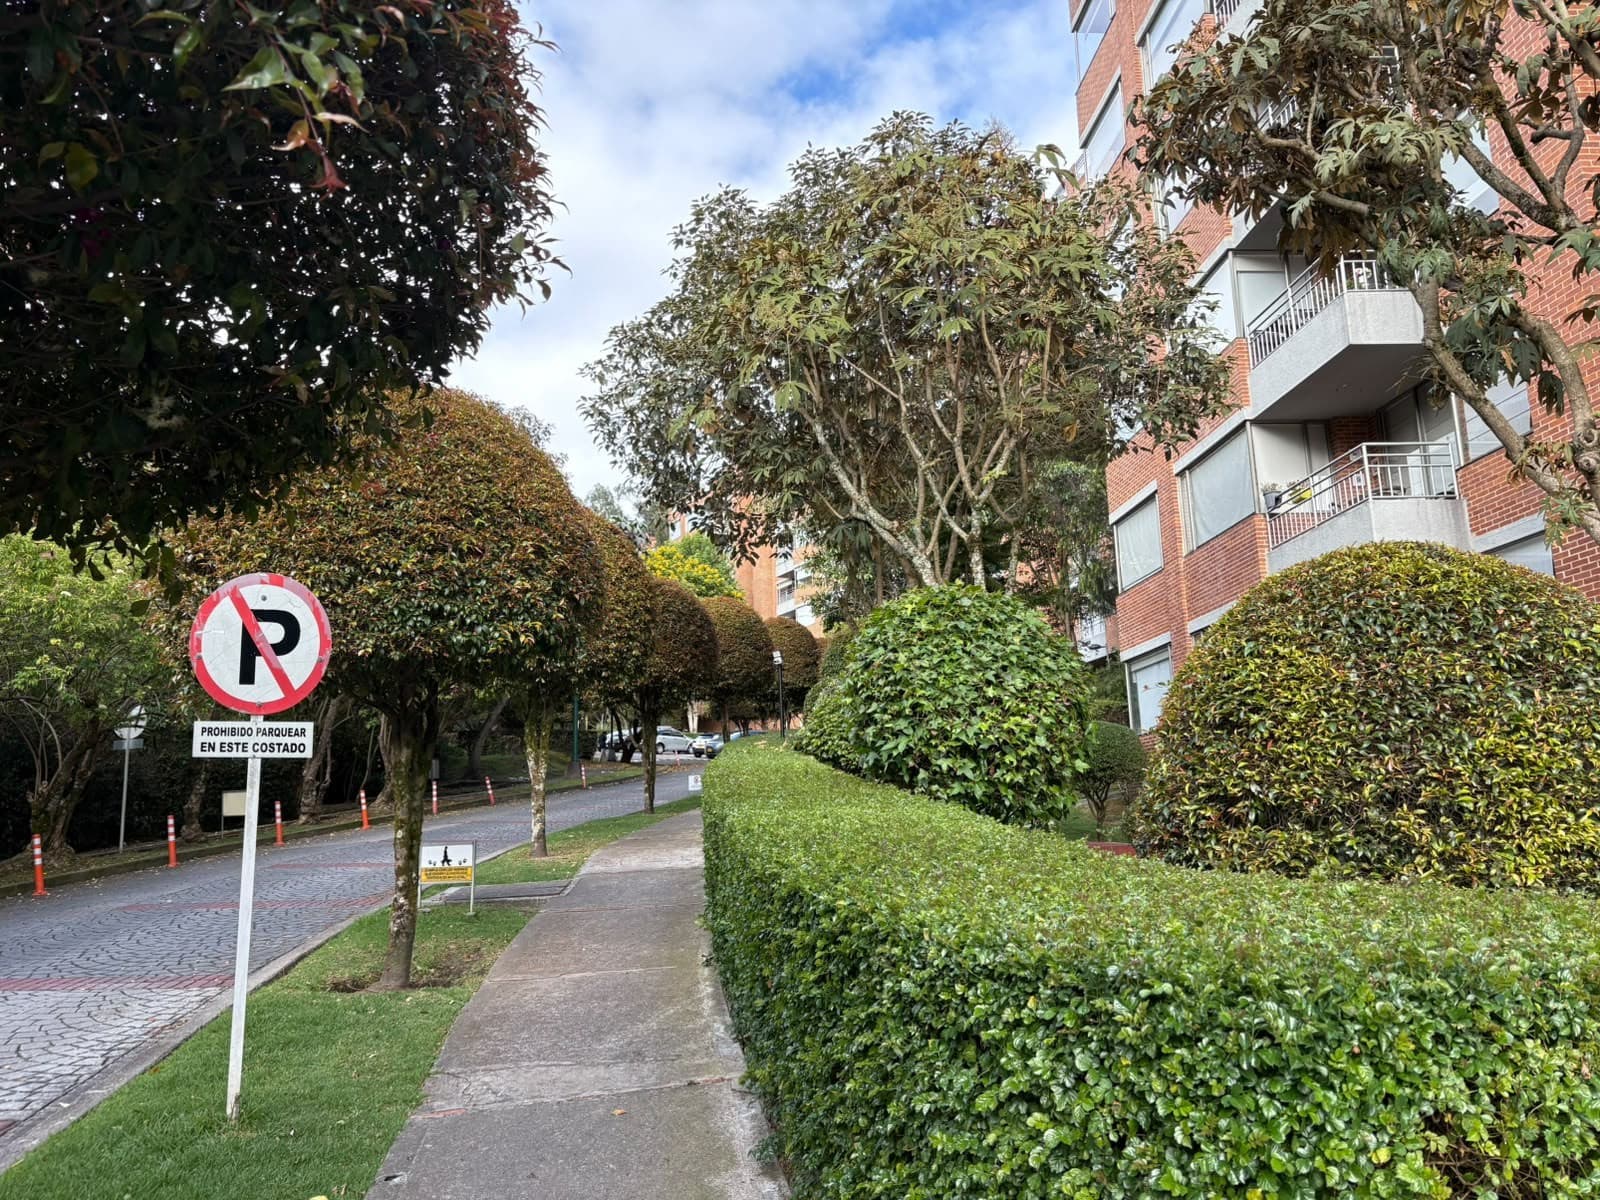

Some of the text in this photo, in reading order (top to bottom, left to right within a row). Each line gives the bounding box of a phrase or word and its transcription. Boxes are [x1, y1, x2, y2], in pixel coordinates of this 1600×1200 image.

[239, 609, 300, 685] P
[201, 726, 306, 738] PROHIBIDO PARQUEAR
[200, 742, 306, 753] EN ESTE COSTADO
